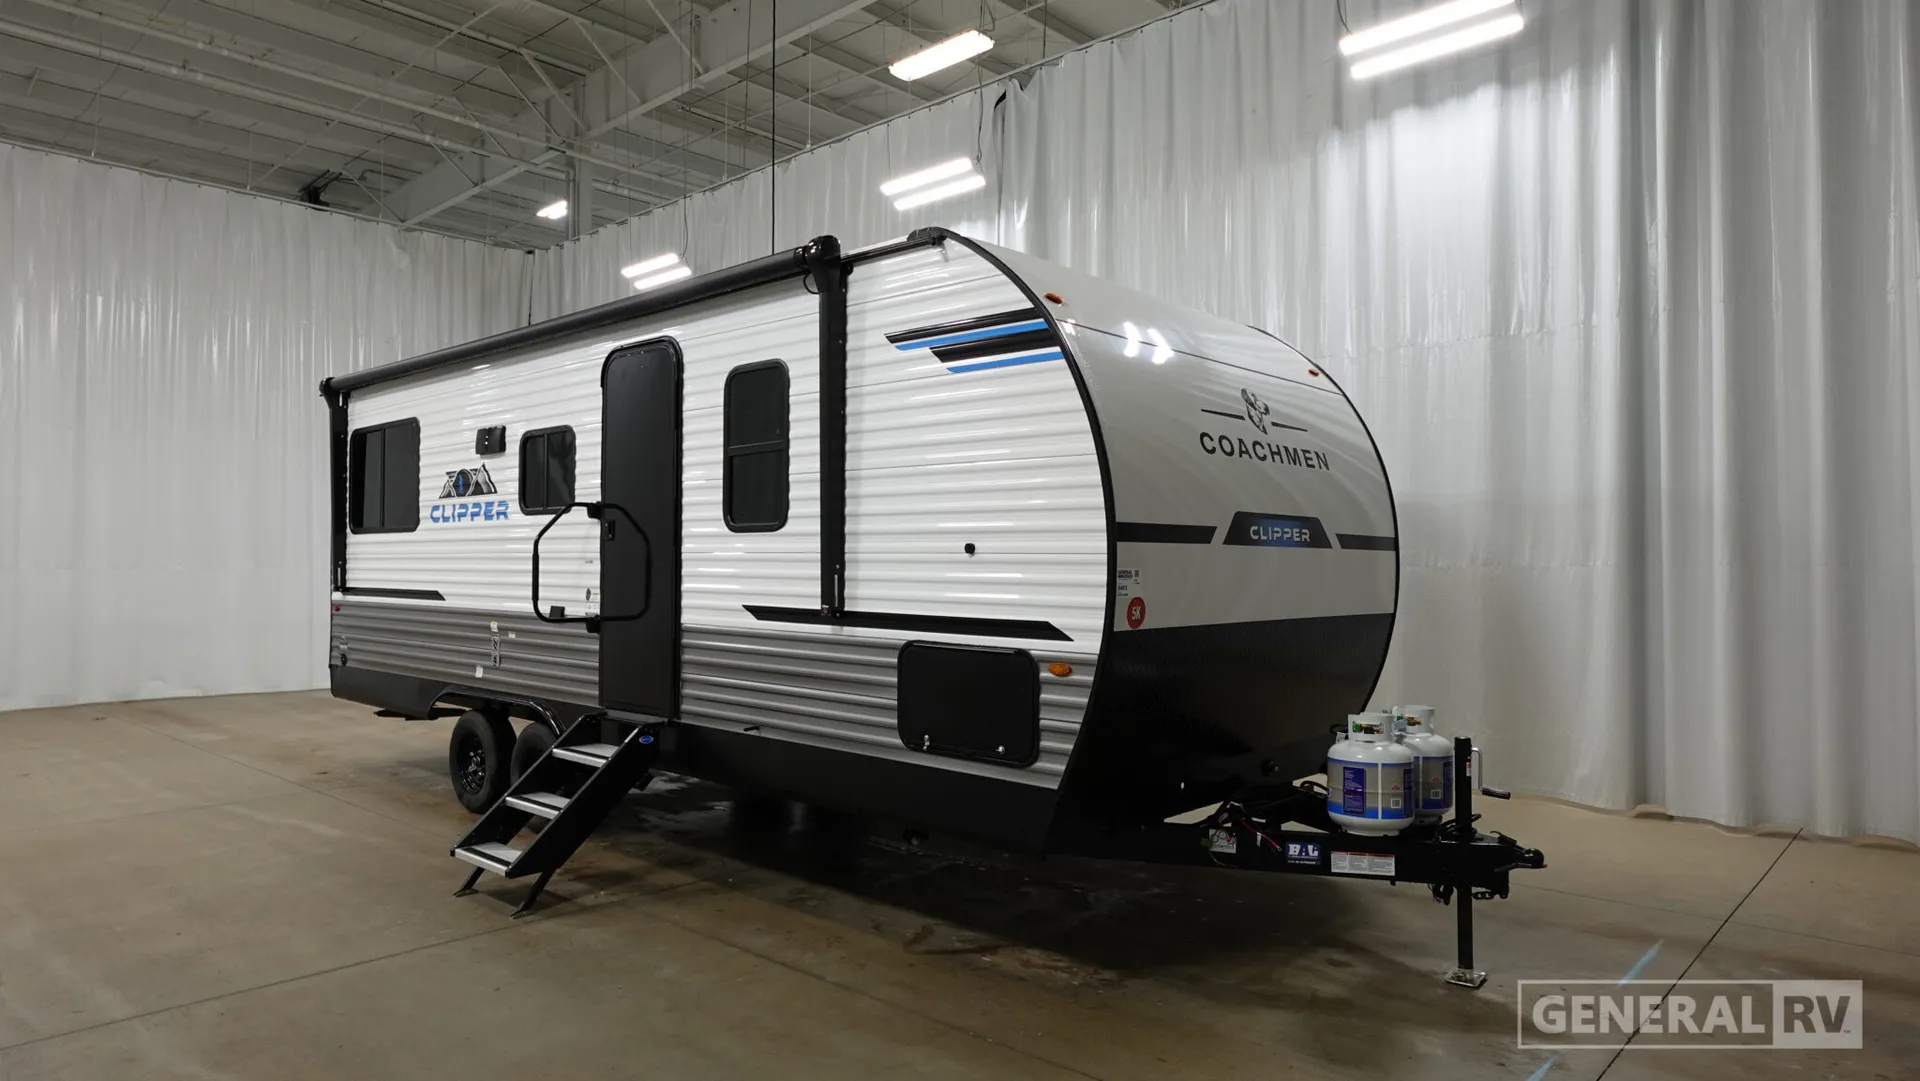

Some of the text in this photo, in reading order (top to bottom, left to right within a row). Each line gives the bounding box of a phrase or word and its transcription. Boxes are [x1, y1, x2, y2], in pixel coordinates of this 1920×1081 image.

[1199, 431, 1330, 471] COACHMEN
[429, 500, 510, 524] CLIPPER
[1249, 525, 1311, 542] CLIPPER
